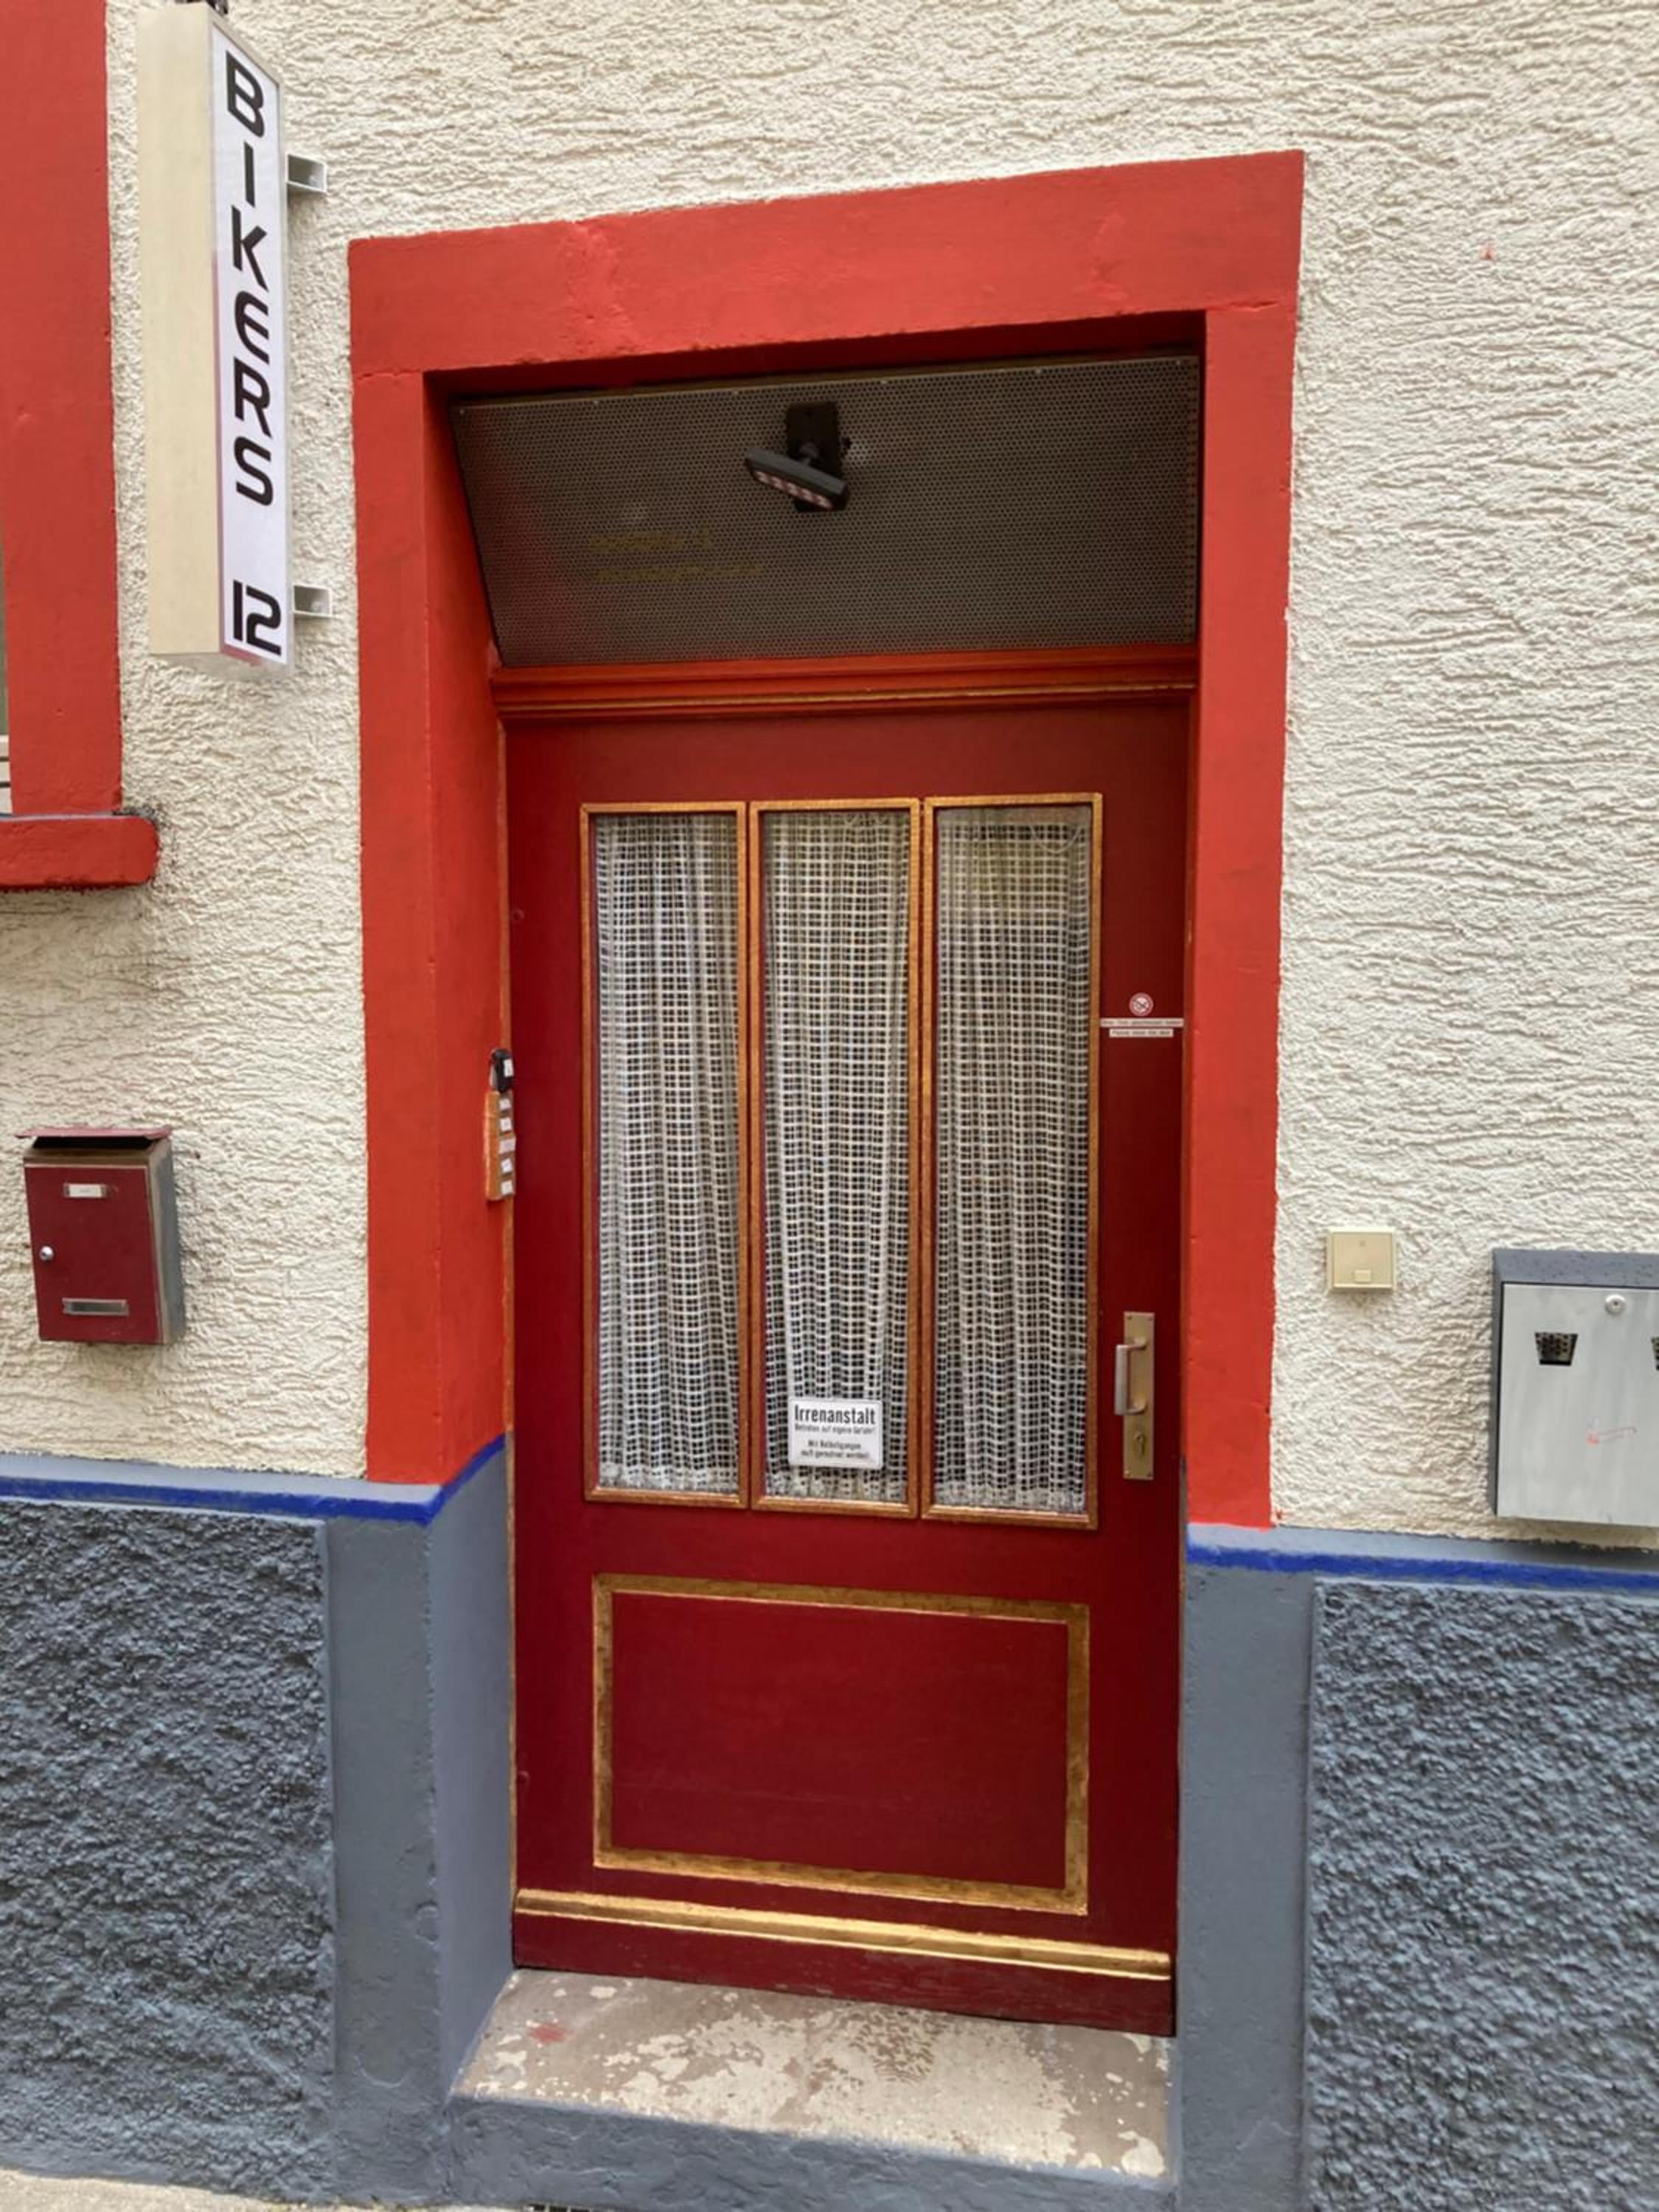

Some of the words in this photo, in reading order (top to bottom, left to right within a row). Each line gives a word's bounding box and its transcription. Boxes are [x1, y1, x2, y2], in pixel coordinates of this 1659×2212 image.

[226, 51, 274, 507] BIKERS
[233, 579, 282, 656] 12
[794, 1404, 875, 1425] Irrenanstalt
